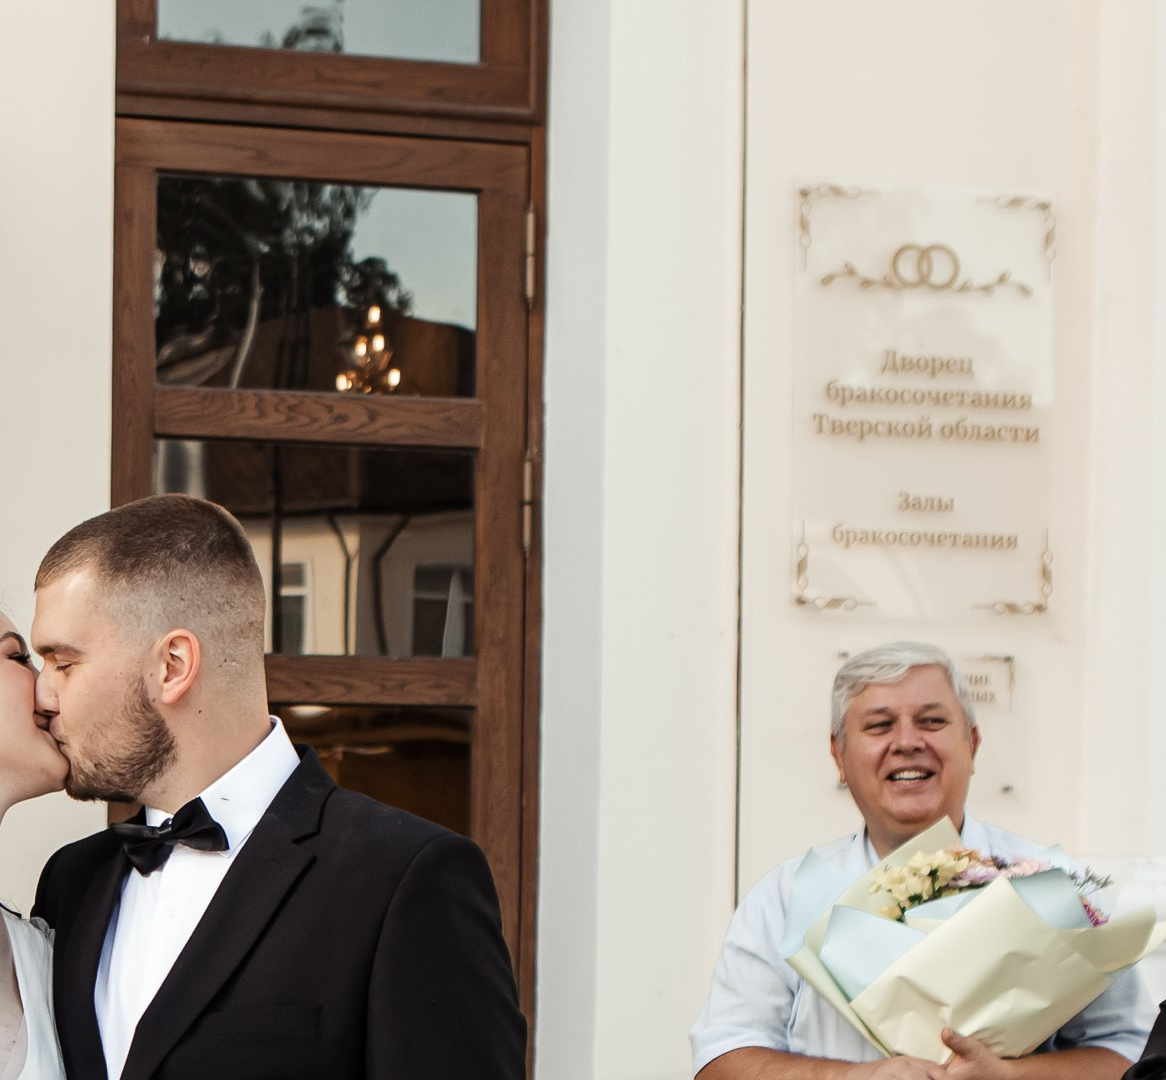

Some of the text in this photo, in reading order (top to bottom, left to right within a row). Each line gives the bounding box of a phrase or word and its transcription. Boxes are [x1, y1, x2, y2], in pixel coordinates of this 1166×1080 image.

[881, 349, 974, 379] Дворец
[825, 379, 1033, 410] бракосочетания
[813, 413, 1041, 444] Тверской области
[897, 491, 955, 513] Залы
[832, 523, 1019, 550] бракосочетания
